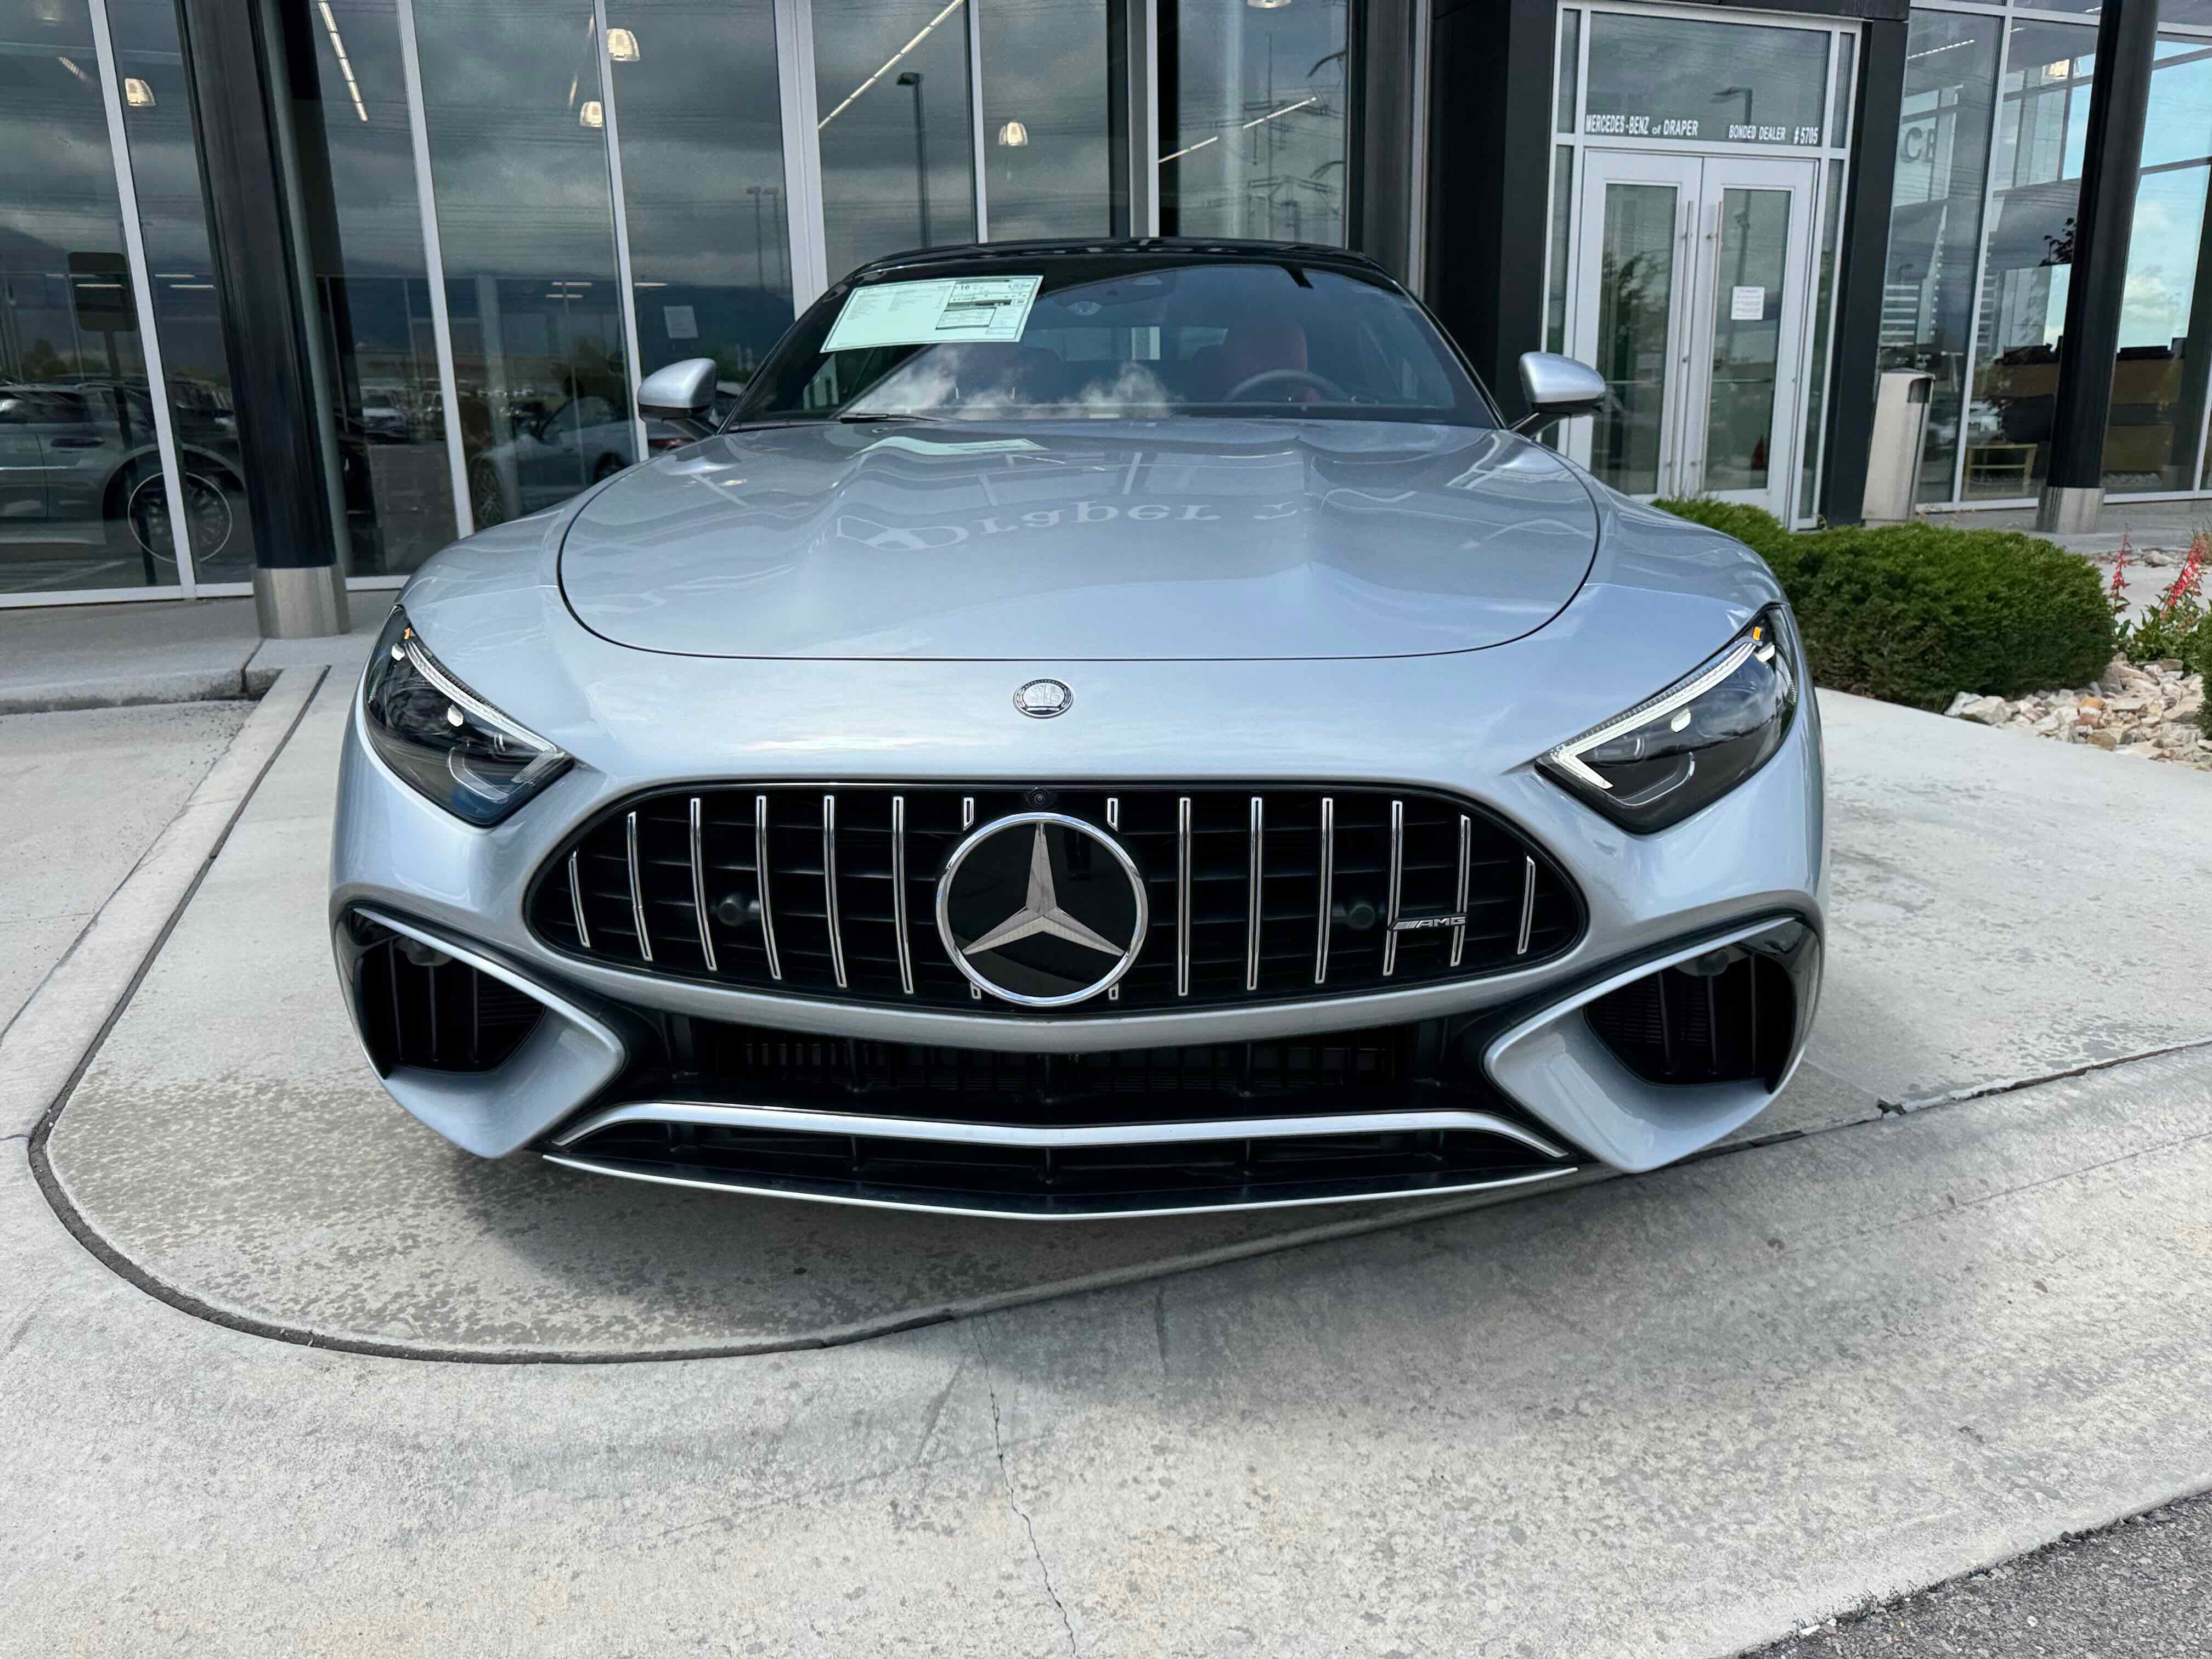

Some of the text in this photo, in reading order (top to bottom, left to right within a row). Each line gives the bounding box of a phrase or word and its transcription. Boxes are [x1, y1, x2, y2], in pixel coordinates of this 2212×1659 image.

[1585, 114, 1699, 136] MERCEDES-BENZ of DRAPER
[1729, 125, 1756, 139] BONDED
[1758, 126, 1786, 141] DEALER
[1415, 916, 1466, 928] AMG
